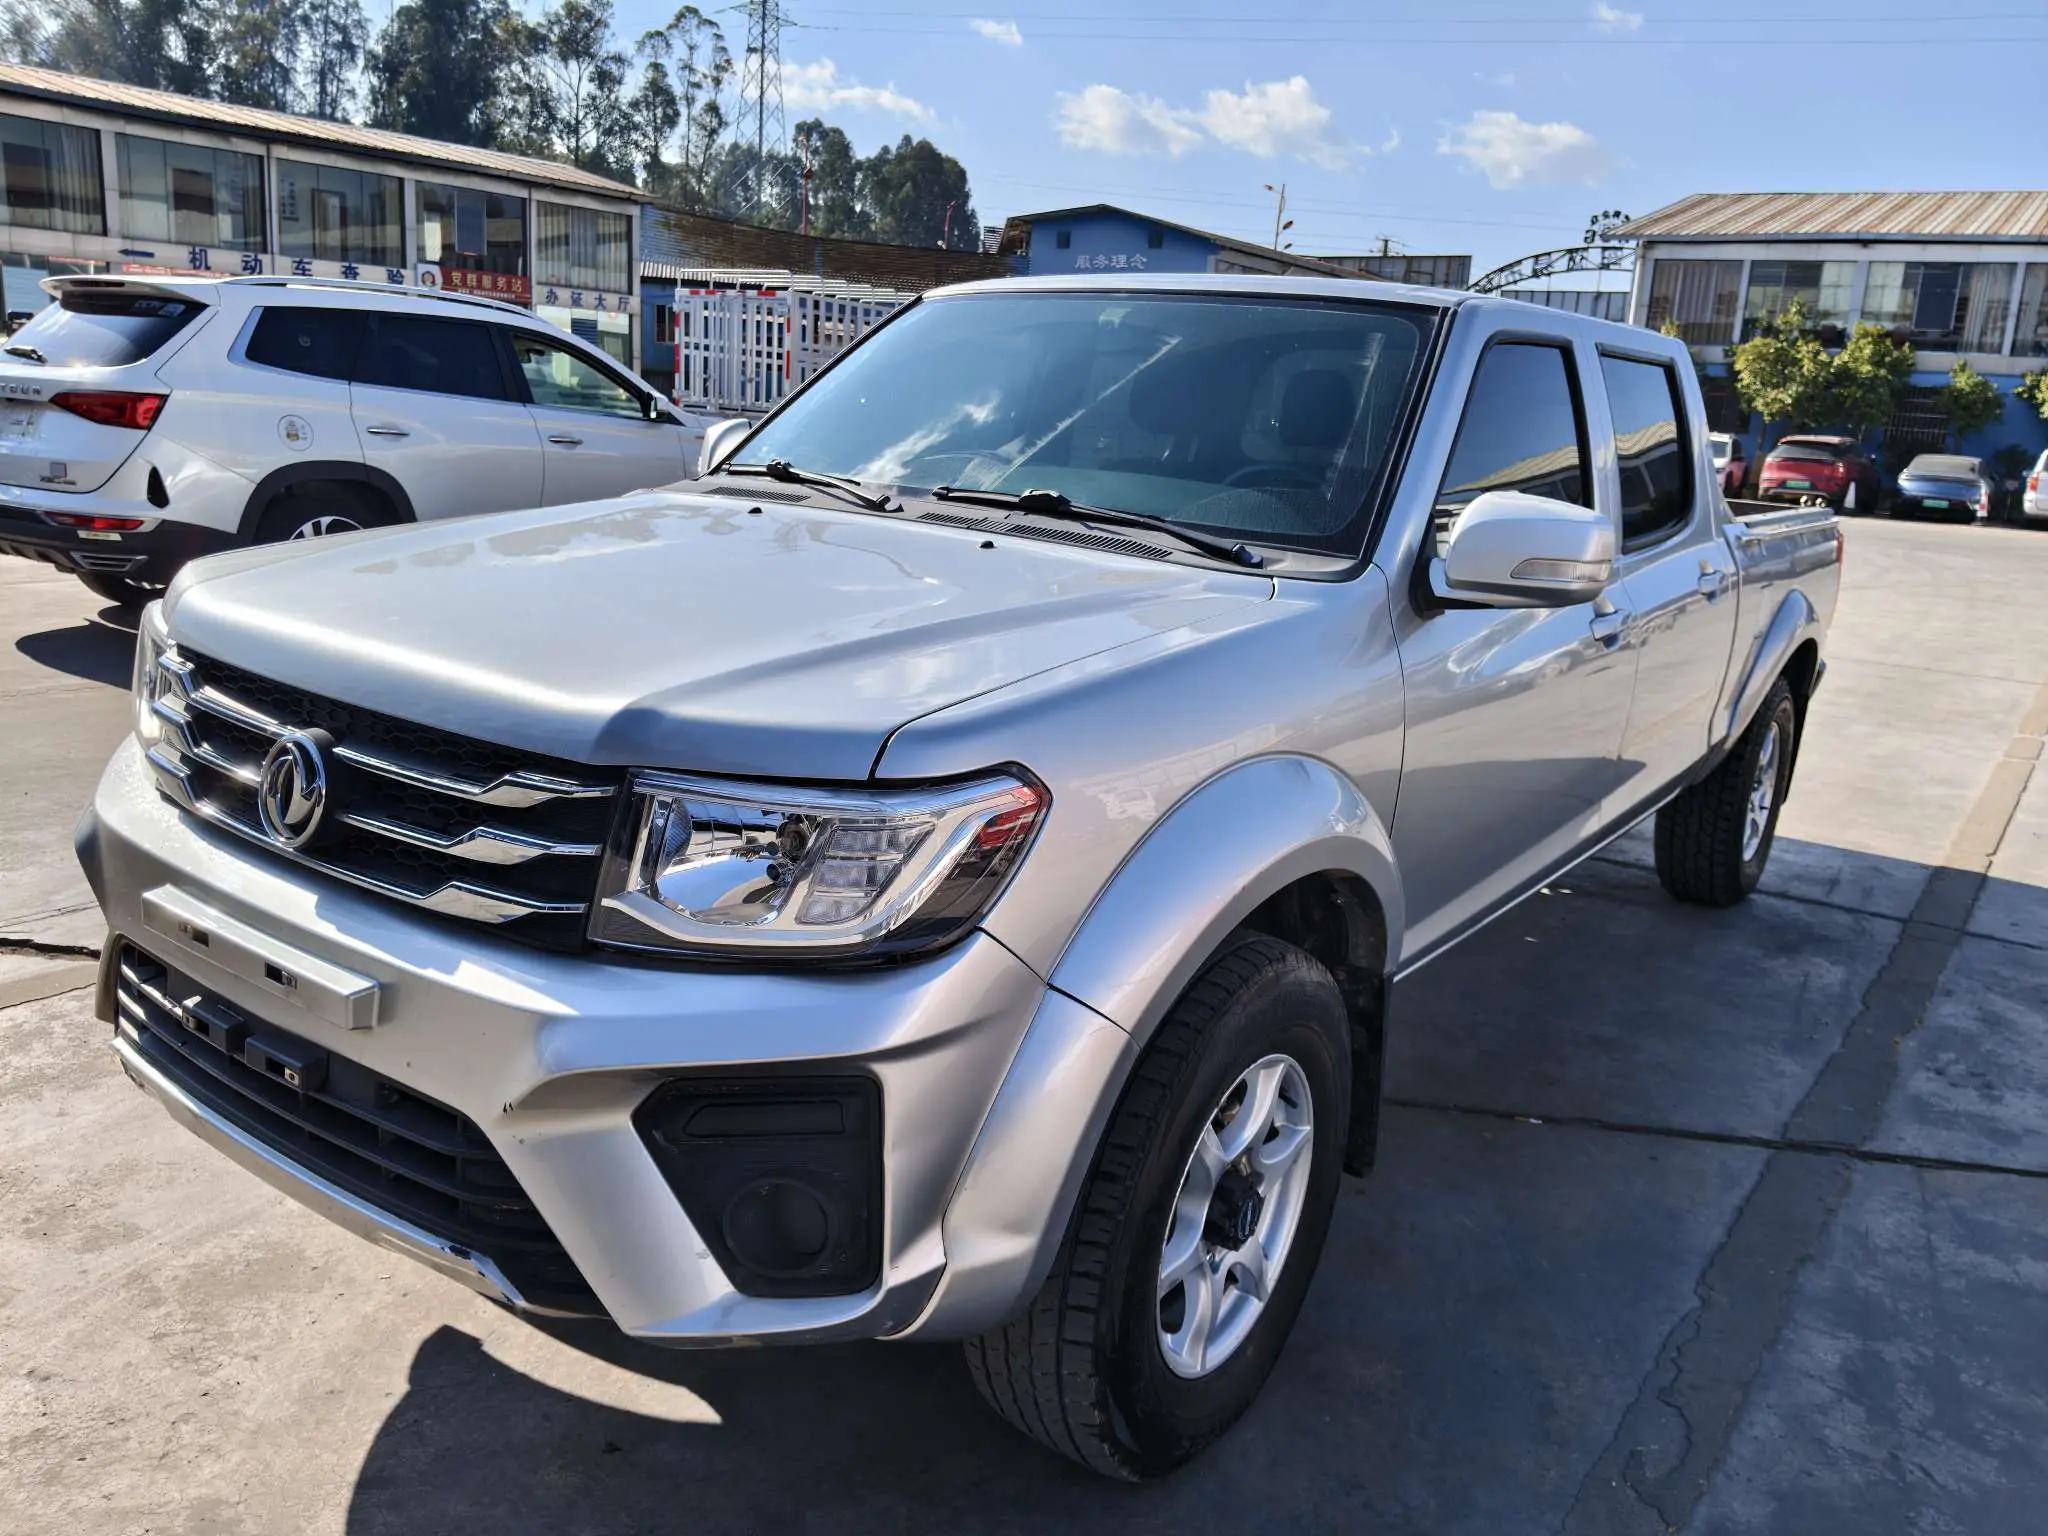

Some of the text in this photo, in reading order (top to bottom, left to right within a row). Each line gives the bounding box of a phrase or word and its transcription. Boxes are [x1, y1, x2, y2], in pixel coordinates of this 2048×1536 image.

[1074, 253, 1148, 270] 服务理念
[451, 271, 522, 292] 党群服务站
[545, 288, 630, 312] 办证大厅
